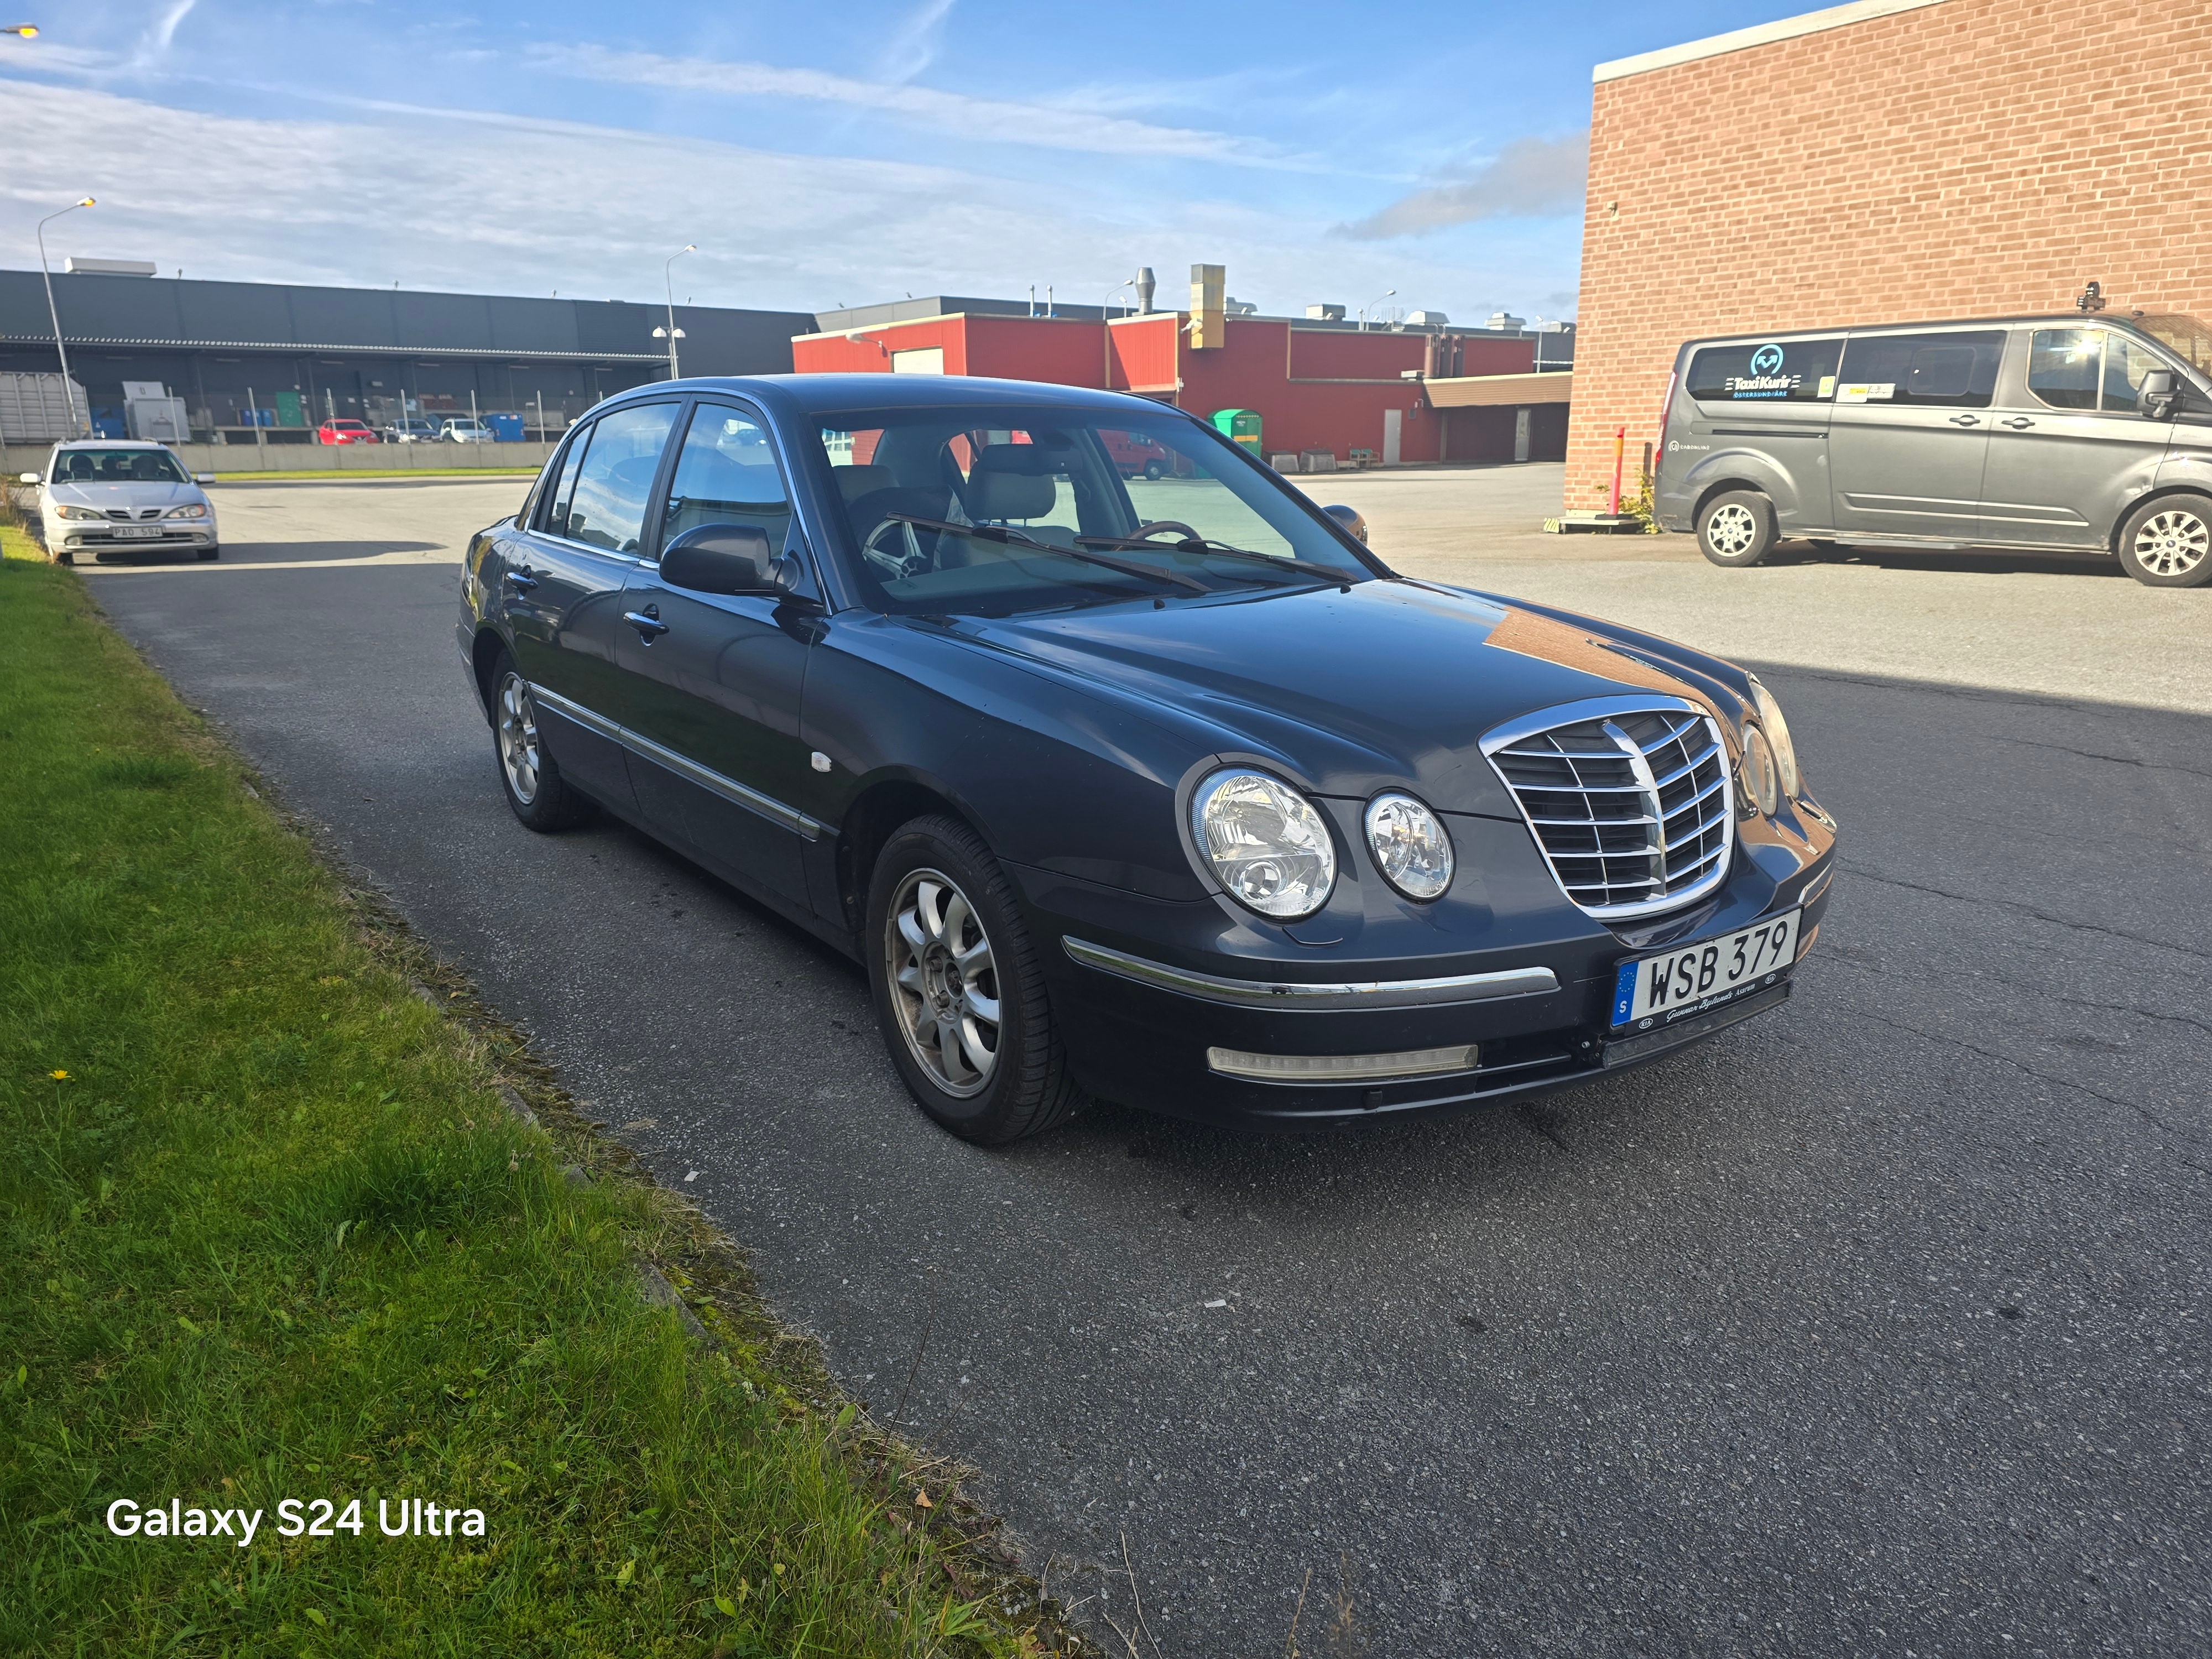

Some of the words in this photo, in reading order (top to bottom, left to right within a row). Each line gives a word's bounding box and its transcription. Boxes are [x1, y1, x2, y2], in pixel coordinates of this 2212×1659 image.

[1734, 375, 1792, 390] TaxiKurir
[1650, 945, 1719, 1008] WSB
[1728, 921, 1788, 980] 379
[1766, 974, 1775, 983] KIA
[1619, 1000, 1627, 1014] S
[1666, 1005, 1698, 1022] Gunnar
[1699, 991, 1733, 1010] Bylunds
[1640, 1019, 1652, 1027] KIA
